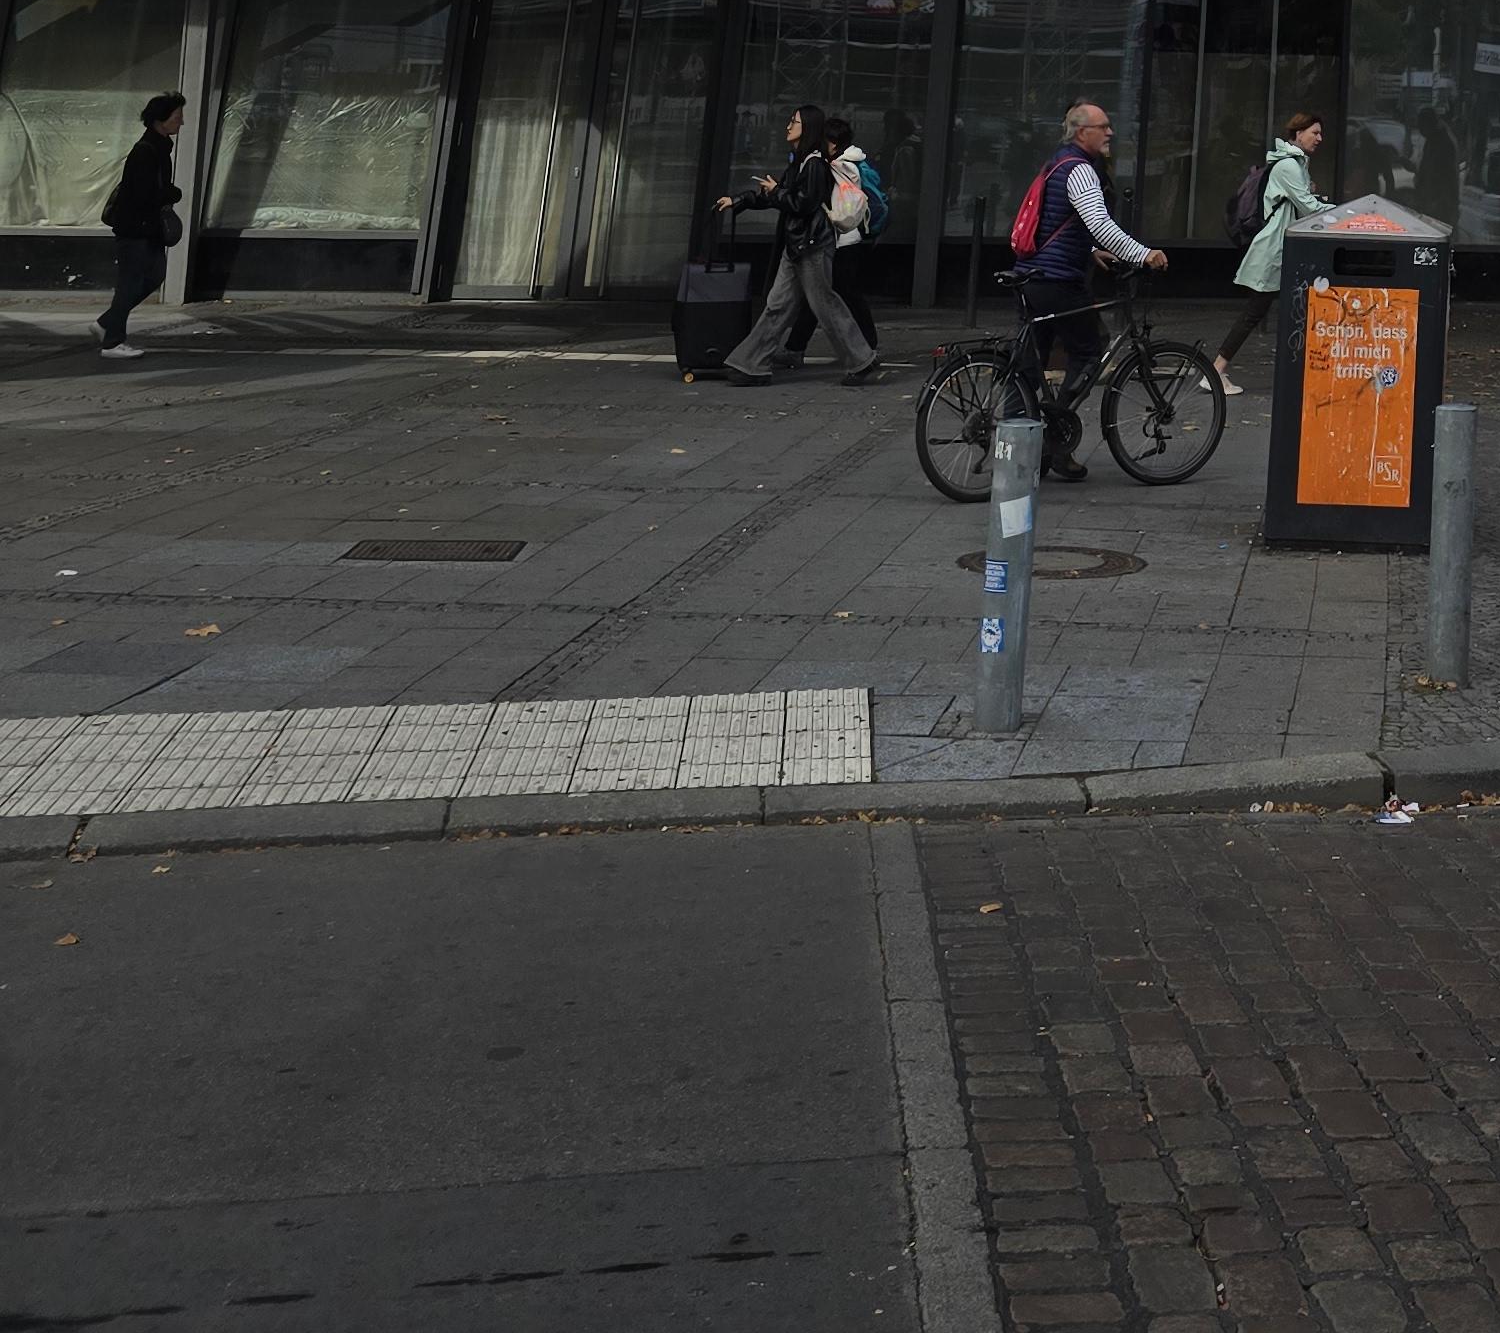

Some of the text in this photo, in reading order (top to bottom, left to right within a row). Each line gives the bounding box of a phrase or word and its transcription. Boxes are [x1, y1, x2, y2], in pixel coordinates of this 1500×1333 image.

[1316, 321, 1408, 341] Schön, dass
[1330, 338, 1350, 358] du
[1353, 341, 1391, 359] mich
[1377, 460, 1400, 483] BSR
